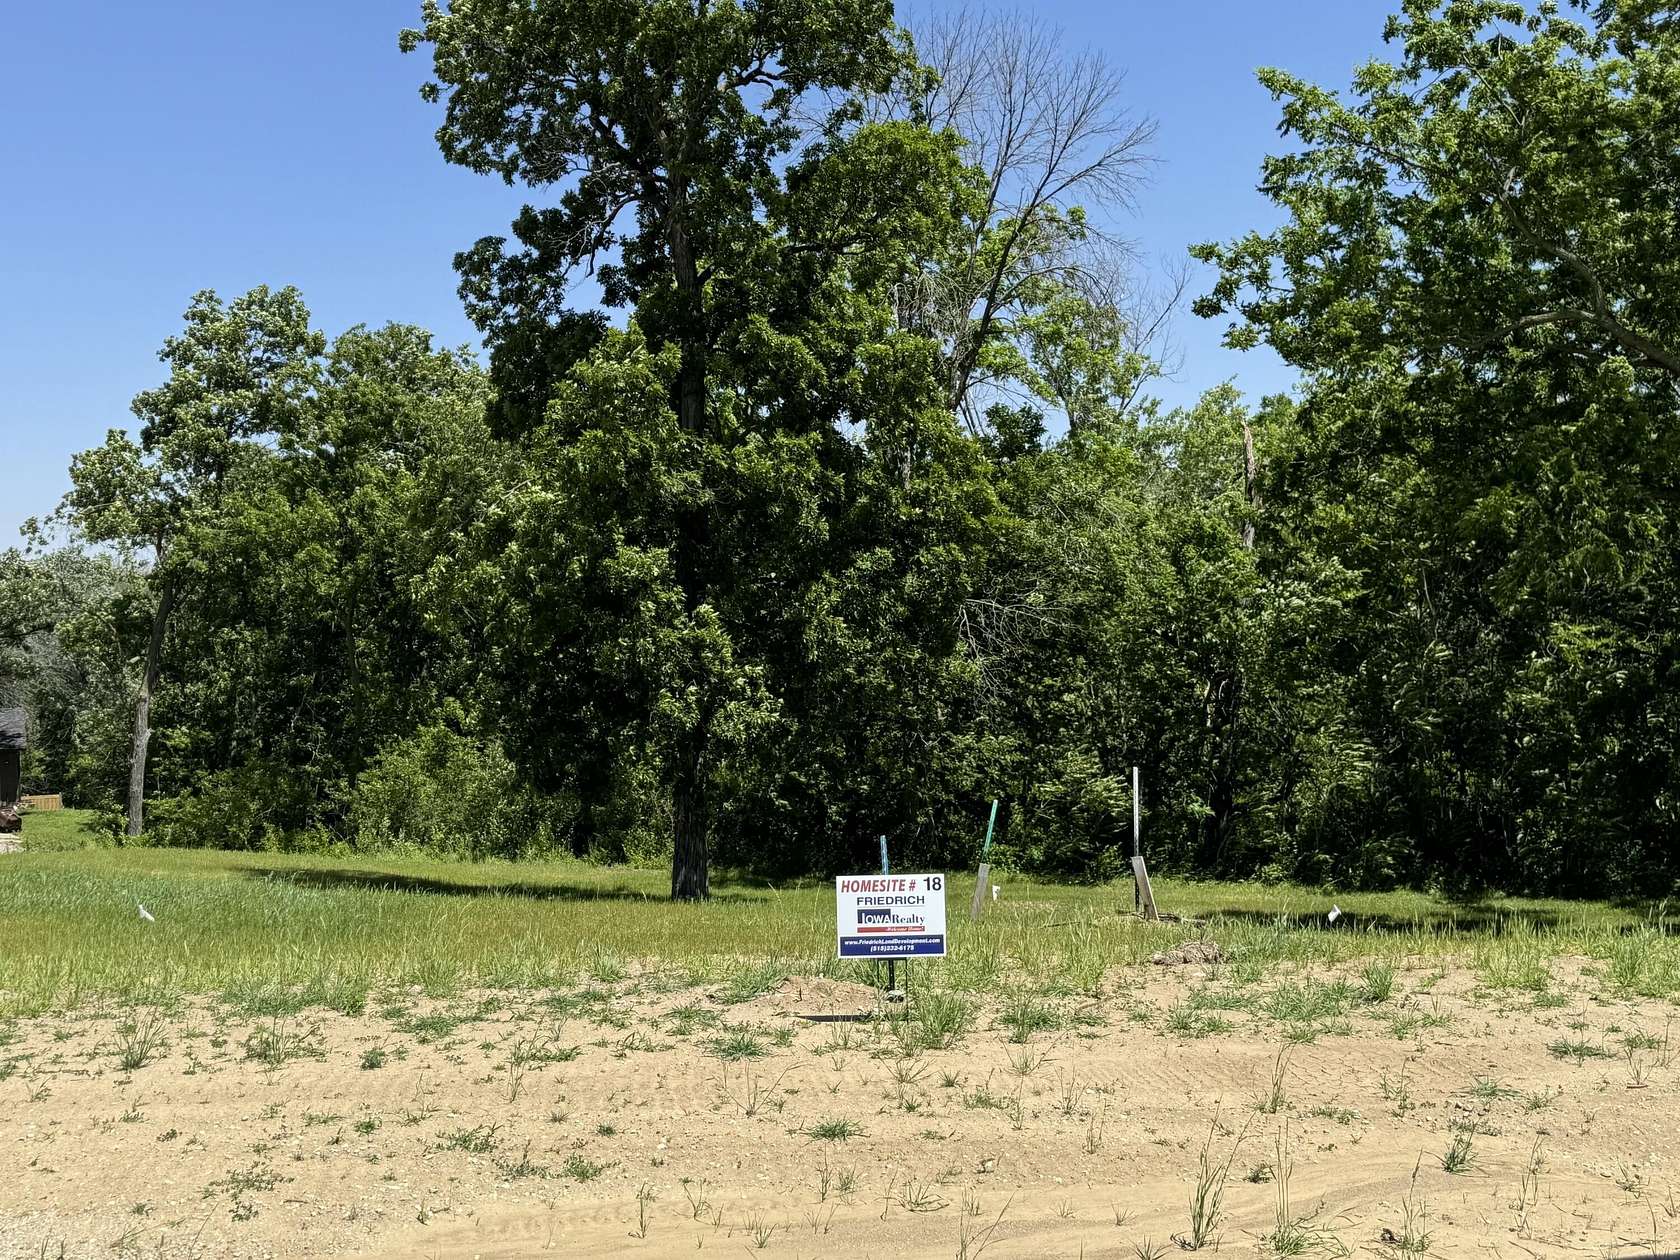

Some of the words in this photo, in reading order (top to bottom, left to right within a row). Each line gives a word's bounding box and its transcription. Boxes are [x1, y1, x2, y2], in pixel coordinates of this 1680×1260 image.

[841, 879, 906, 893] HOMESITE
[909, 879, 917, 892] #
[923, 877, 942, 891] 18
[857, 896, 925, 906] FRIEDRICH
